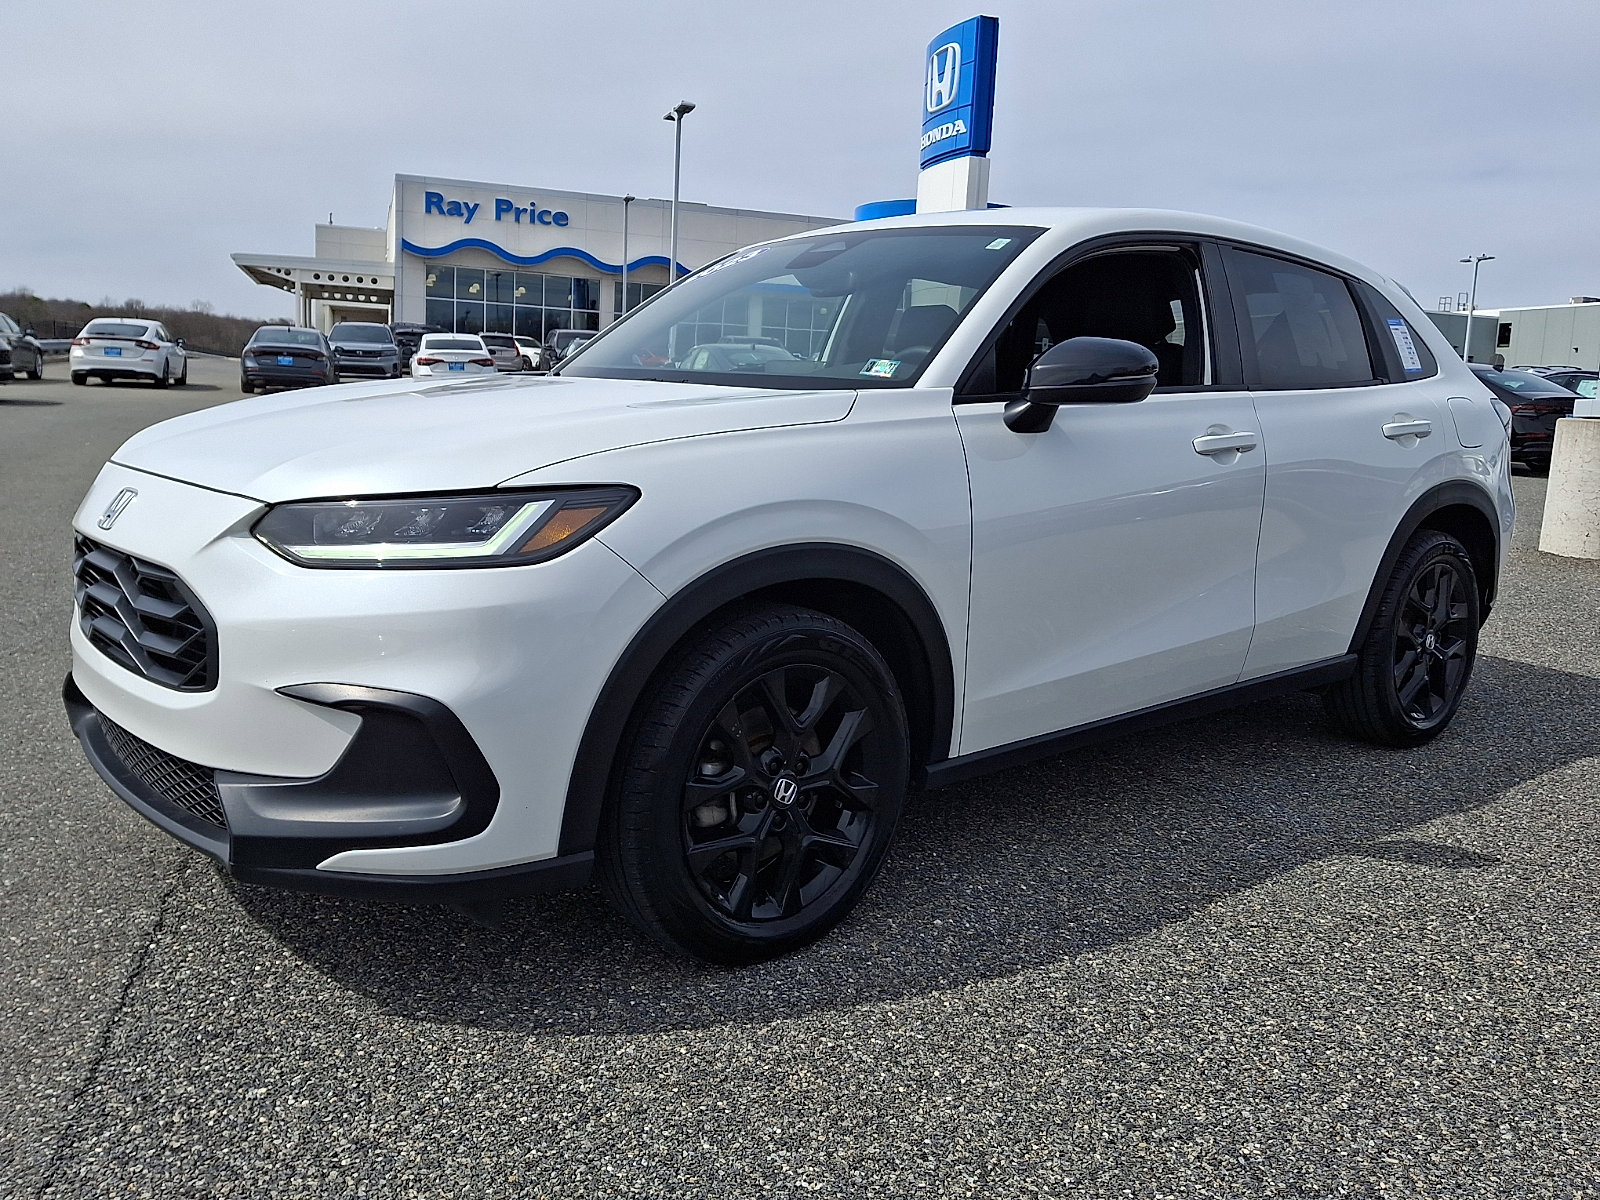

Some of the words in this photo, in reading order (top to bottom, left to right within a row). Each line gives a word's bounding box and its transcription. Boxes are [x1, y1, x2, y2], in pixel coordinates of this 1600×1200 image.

[919, 119, 967, 151] HONDA
[424, 191, 480, 224] Ray
[495, 198, 569, 227] Price
